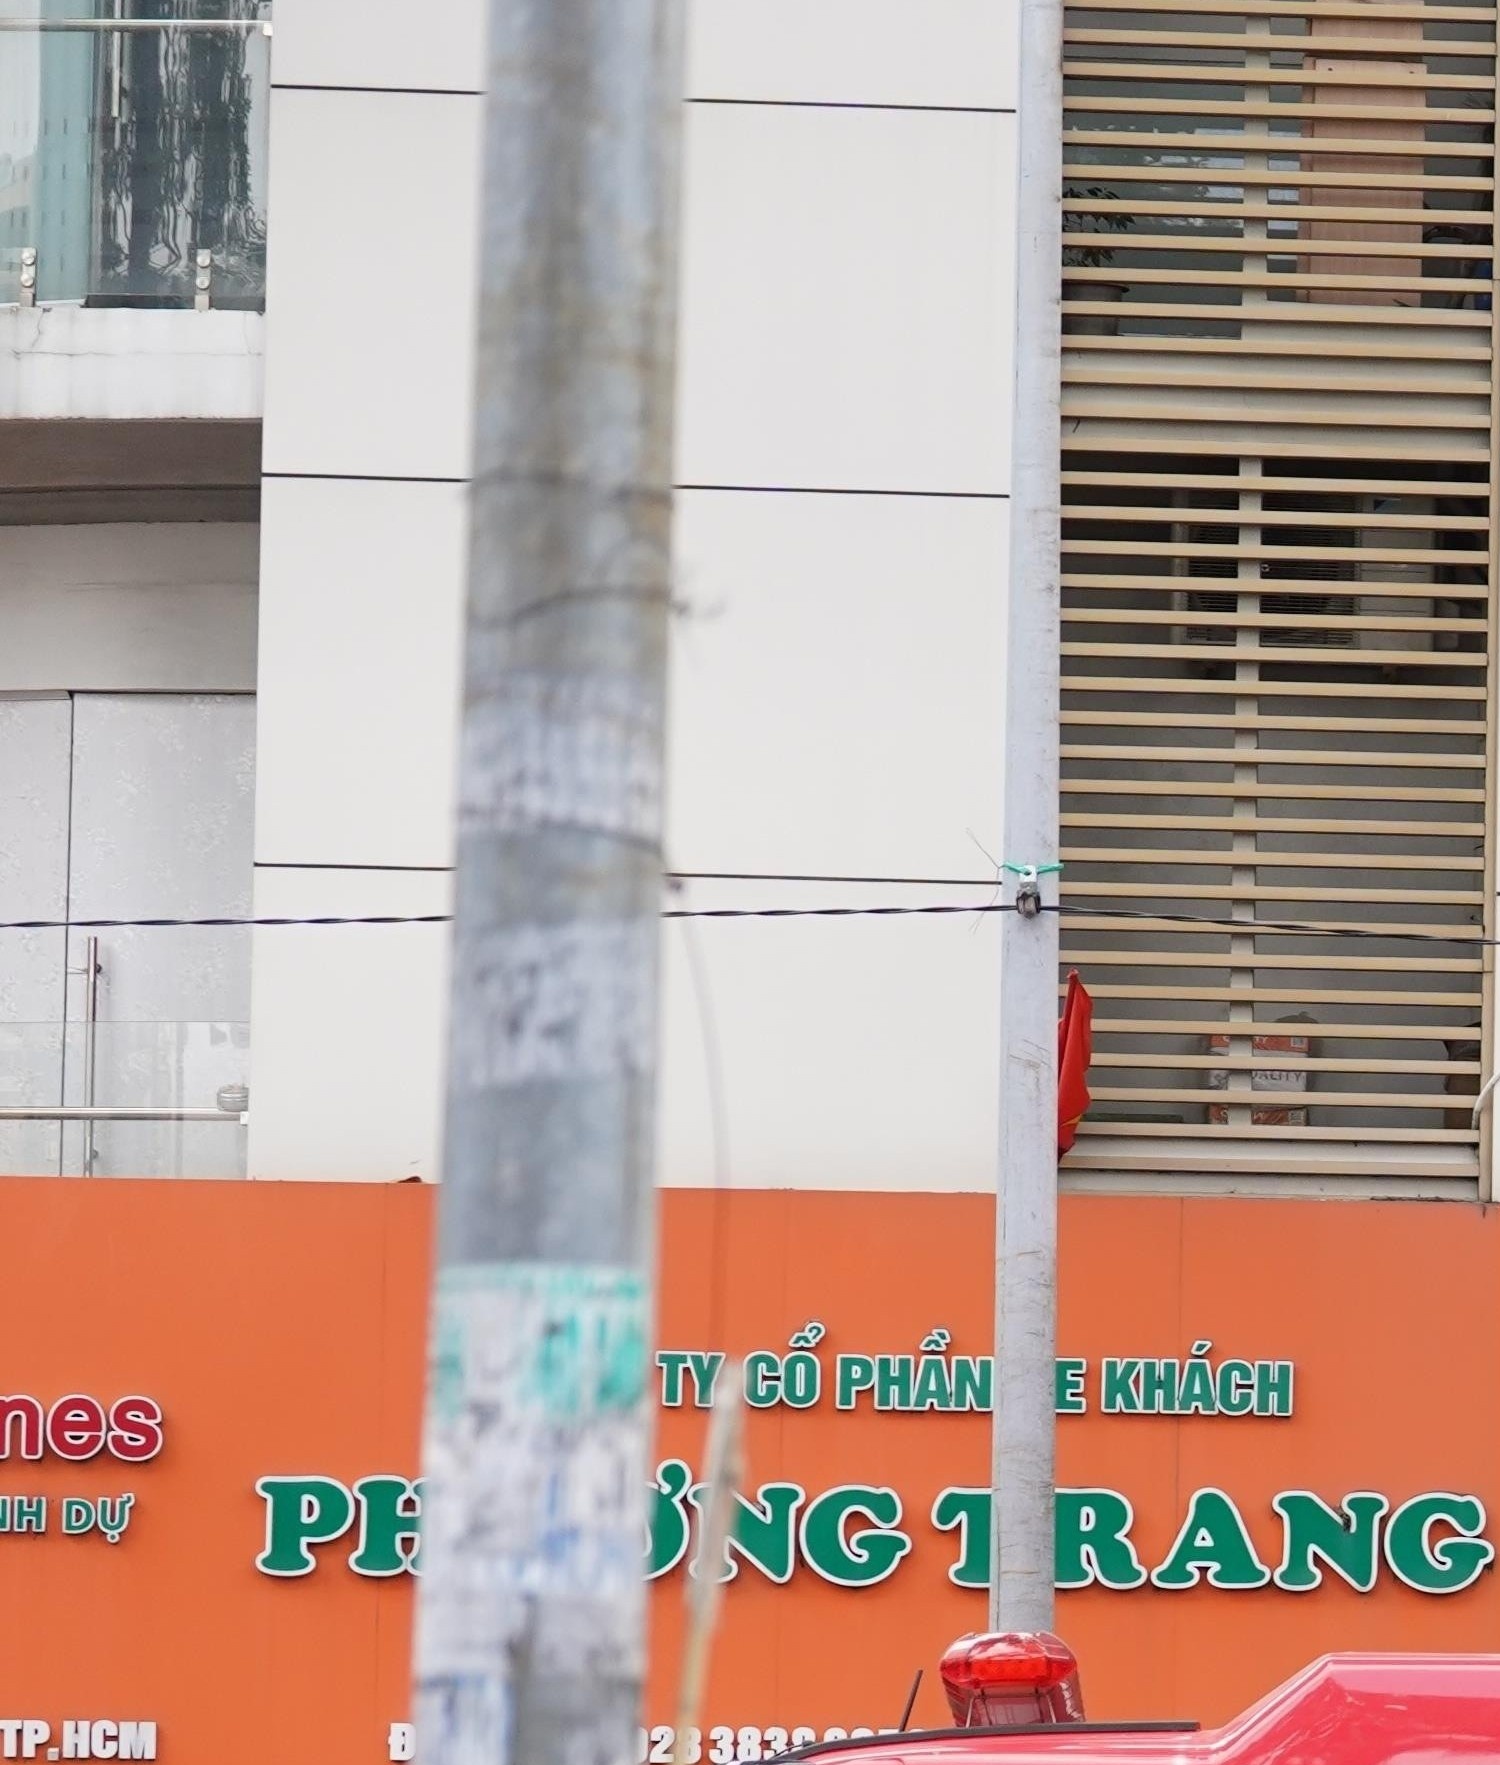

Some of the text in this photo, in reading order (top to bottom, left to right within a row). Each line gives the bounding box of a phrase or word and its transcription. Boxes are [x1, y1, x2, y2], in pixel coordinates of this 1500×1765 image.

[657, 1321, 1294, 1416] TY CỔ PHẦN E KHÁCH
[62, 1492, 135, 1543] DỰ
[0, 1719, 156, 1761] TP.HCM
